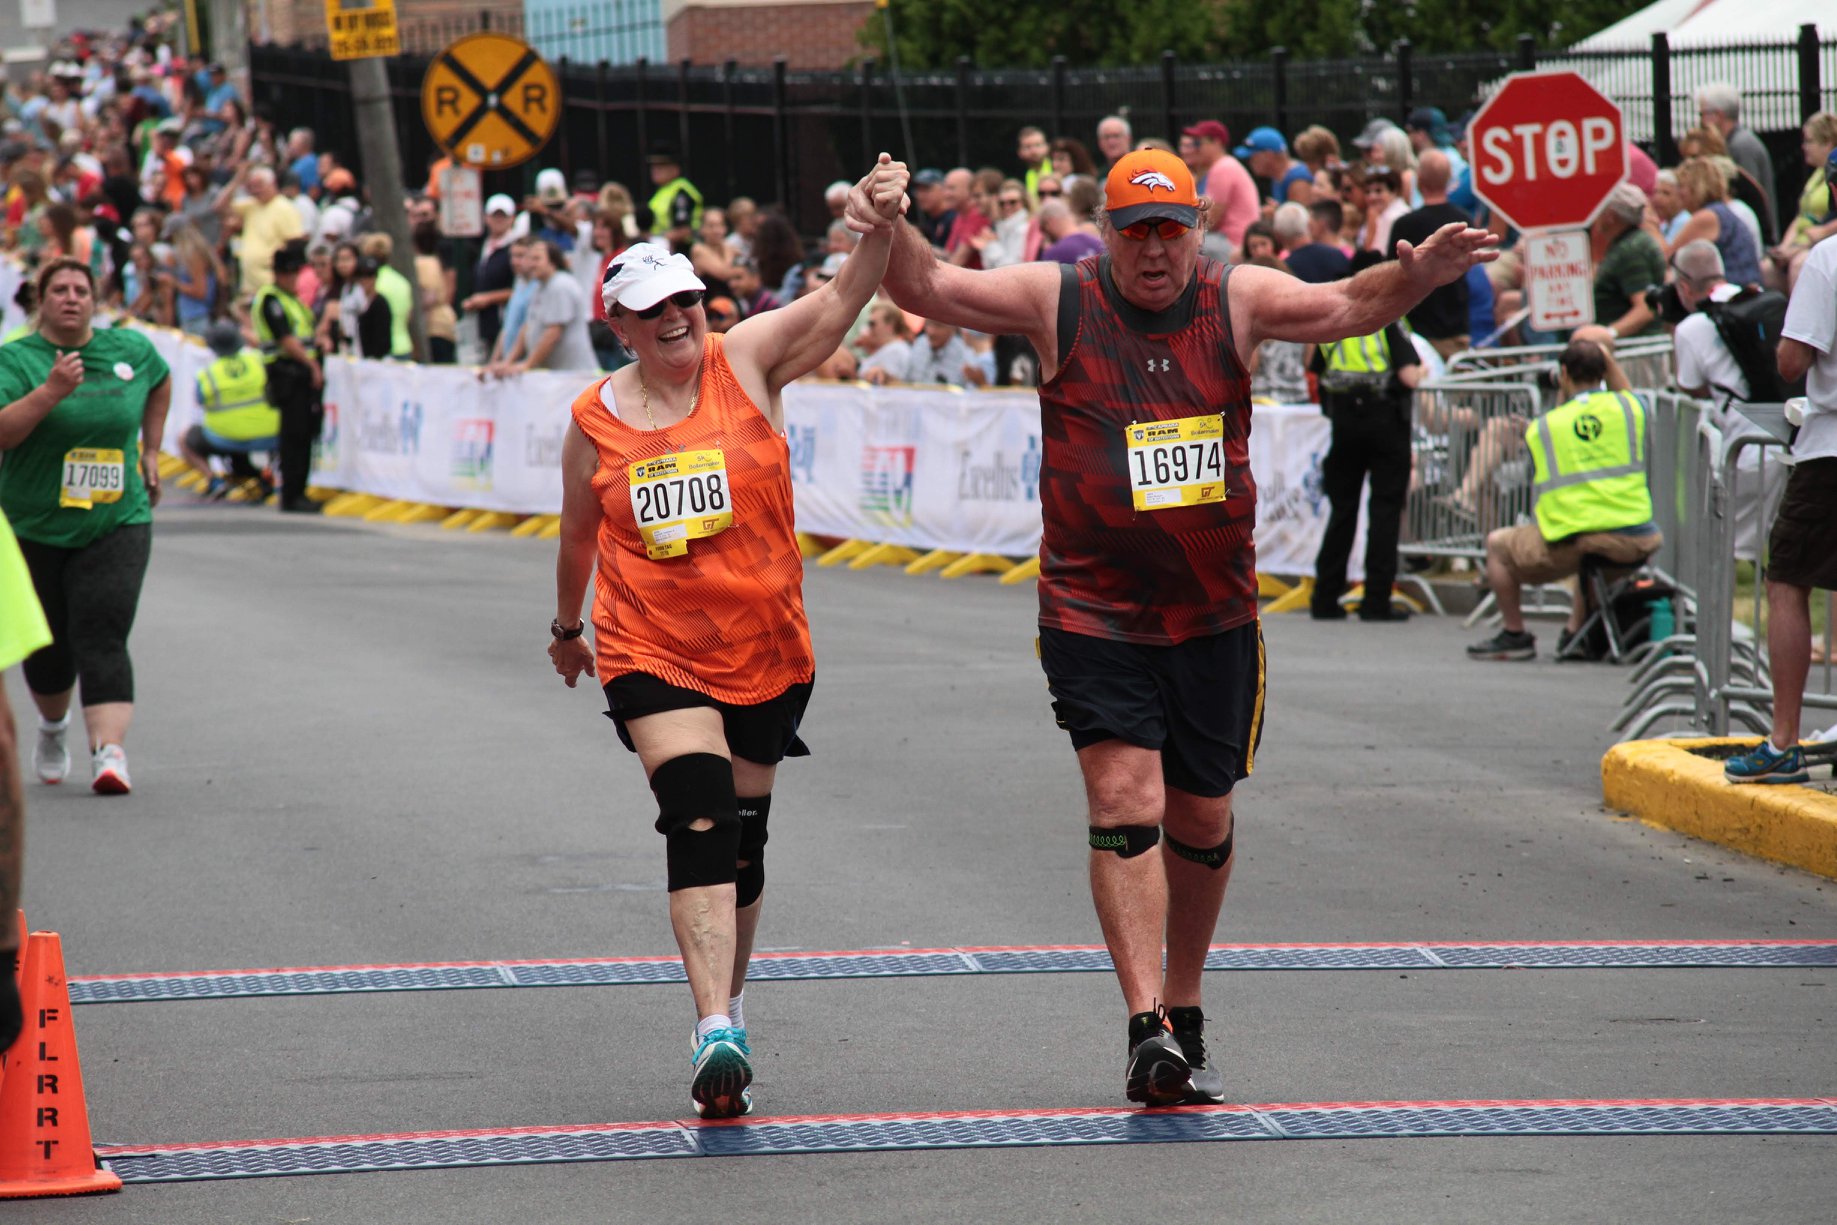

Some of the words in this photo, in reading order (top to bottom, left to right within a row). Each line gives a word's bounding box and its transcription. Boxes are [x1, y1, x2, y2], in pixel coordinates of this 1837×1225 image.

[436, 86, 461, 117] R
[523, 83, 547, 113] R
[1481, 117, 1616, 185] STOP
[1544, 242, 1568, 260] NO
[1530, 263, 1587, 280] PARKING
[1147, 428, 1179, 437] RAM
[66, 463, 120, 489] 17099
[647, 462, 677, 473] RAM
[688, 460, 720, 470] Boilermaker
[1134, 441, 1221, 486] 16974
[636, 473, 724, 523] 20708
[36, 1009, 60, 1160] FLRRT
